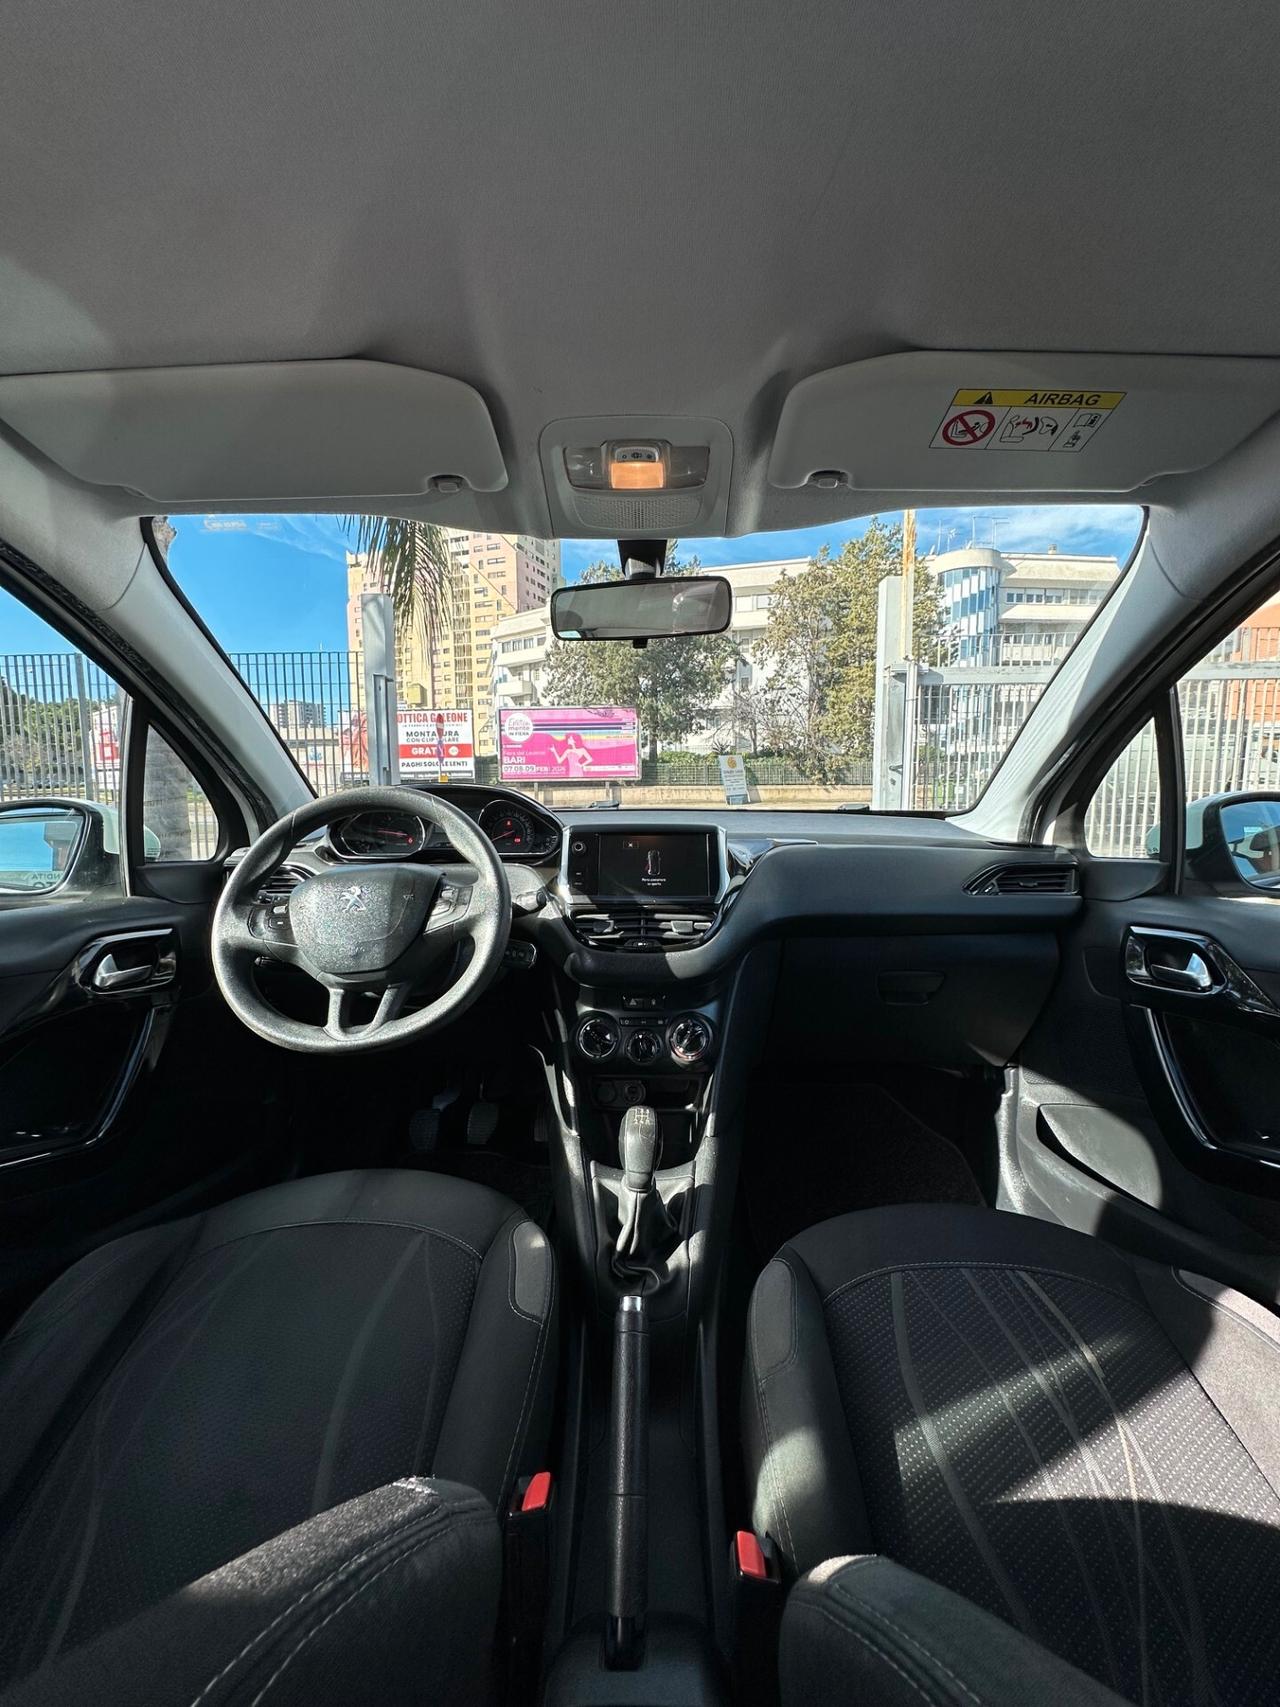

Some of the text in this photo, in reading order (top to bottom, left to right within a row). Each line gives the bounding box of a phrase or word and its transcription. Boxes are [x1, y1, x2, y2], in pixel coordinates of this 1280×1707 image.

[1024, 393, 1101, 406] AIRBAG
[397, 712, 468, 723] OTTICA GLEONE
[406, 730, 459, 738] MONTAURA
[411, 746, 445, 756] GRAT
[503, 756, 526, 764] BARI
